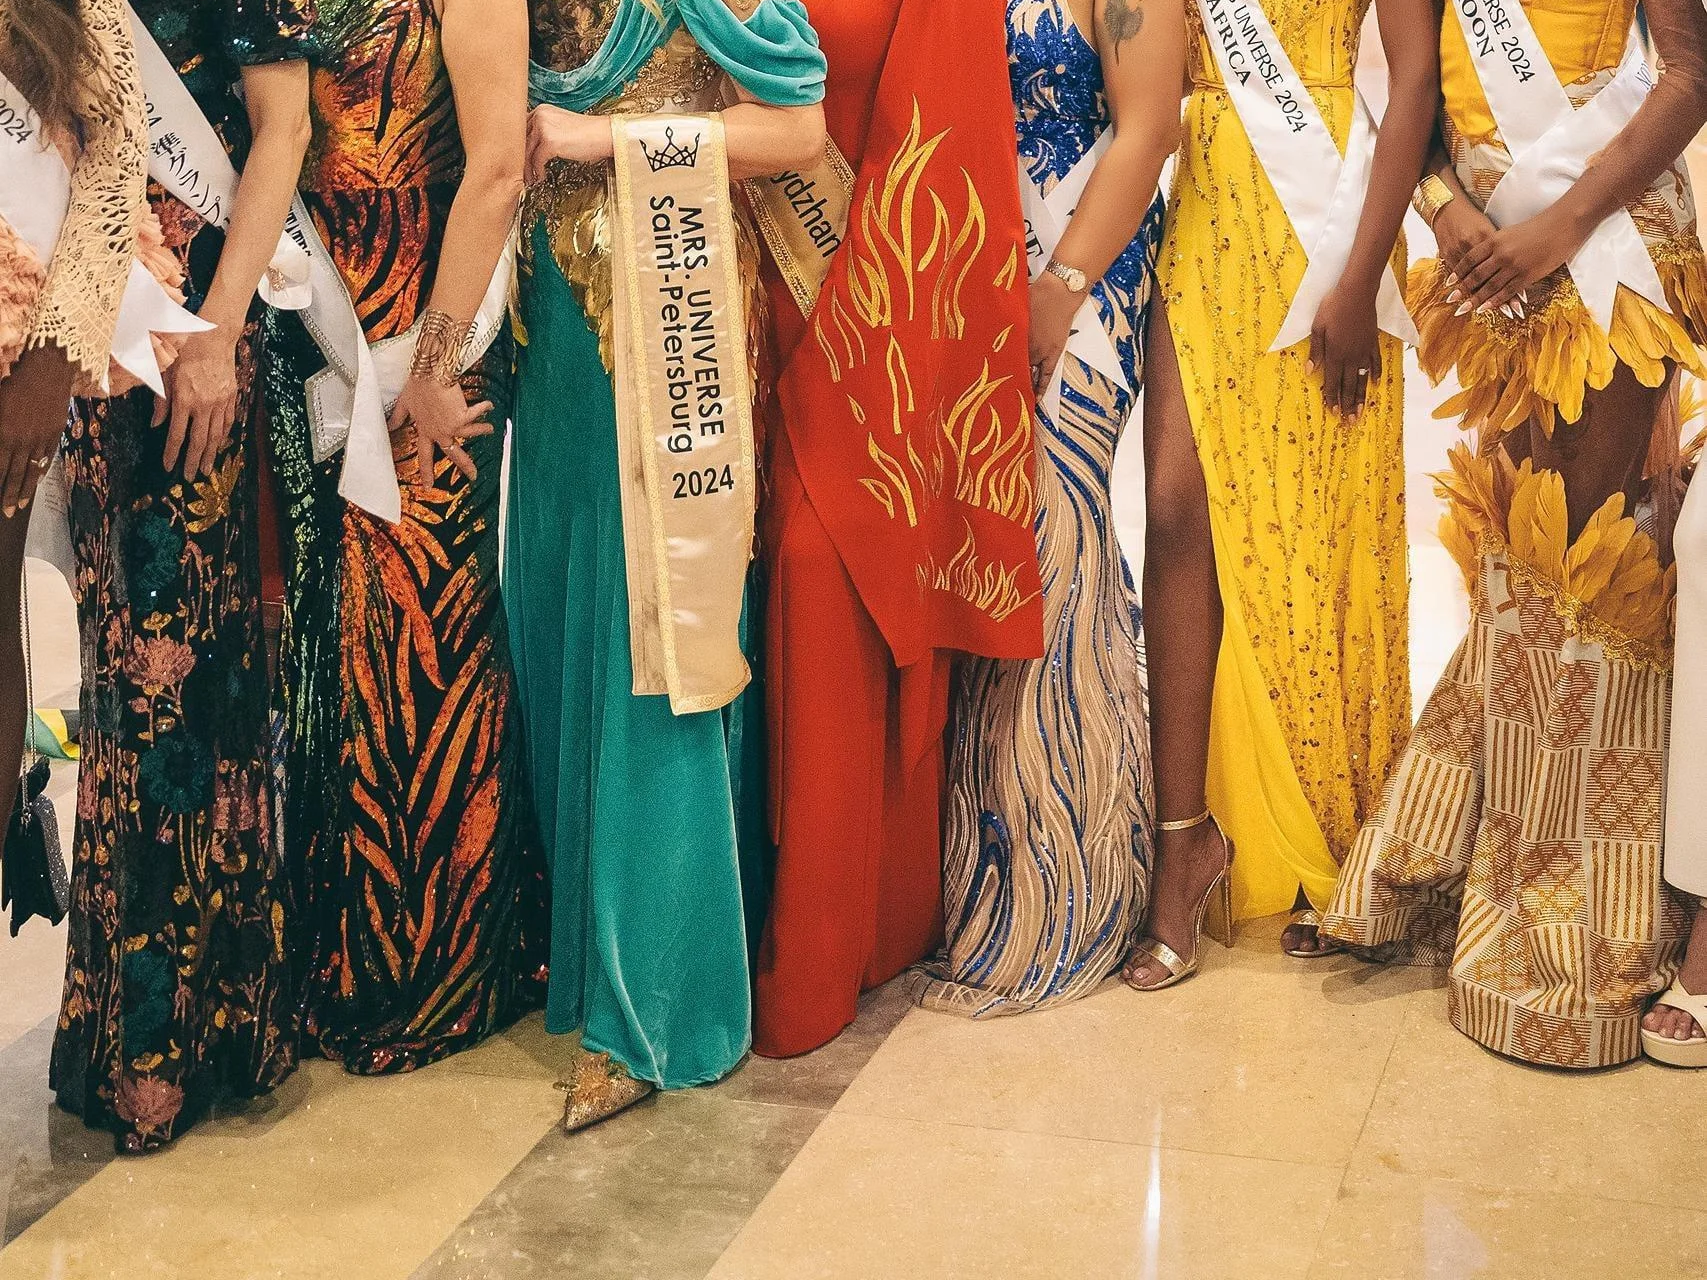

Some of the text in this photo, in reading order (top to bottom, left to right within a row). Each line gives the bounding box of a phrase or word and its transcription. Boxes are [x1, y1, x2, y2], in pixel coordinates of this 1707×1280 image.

[1233, 4, 1284, 89] UNIVERSE
[1275, 90, 1308, 133] 2024
[1500, 37, 1536, 83] 2024
[649, 195, 693, 455] Saint-Petersburg
[678, 206, 725, 436] MRS. UNIVERSE
[672, 464, 735, 499] 2024
